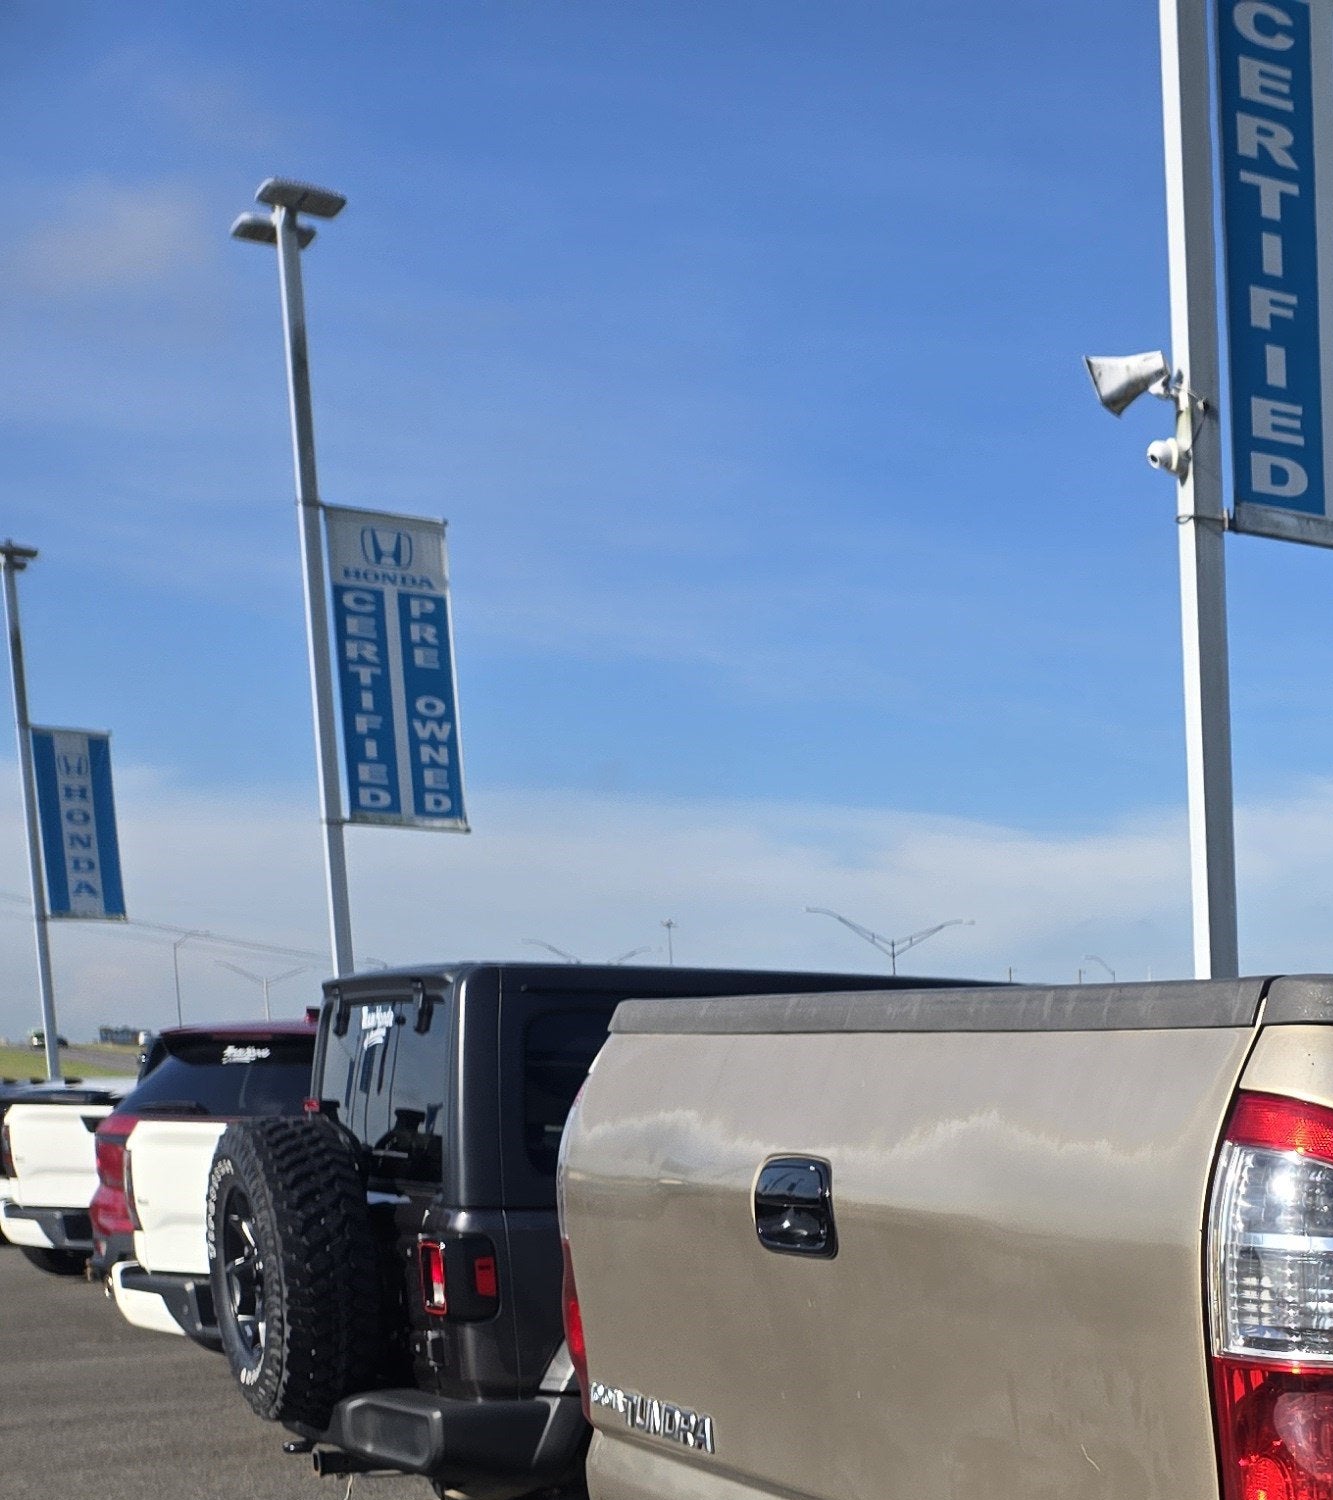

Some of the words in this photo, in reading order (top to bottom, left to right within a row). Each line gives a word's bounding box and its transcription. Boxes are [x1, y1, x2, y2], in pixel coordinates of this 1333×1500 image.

[1232, 0, 1310, 498] CERTIFIED
[341, 567, 435, 590] HONDA
[408, 598, 441, 671] PRE
[342, 590, 392, 809] CERTIFIED
[412, 694, 452, 814] OWNED
[62, 783, 98, 899] HONDA
[624, 1394, 716, 1455] TUNDRA
